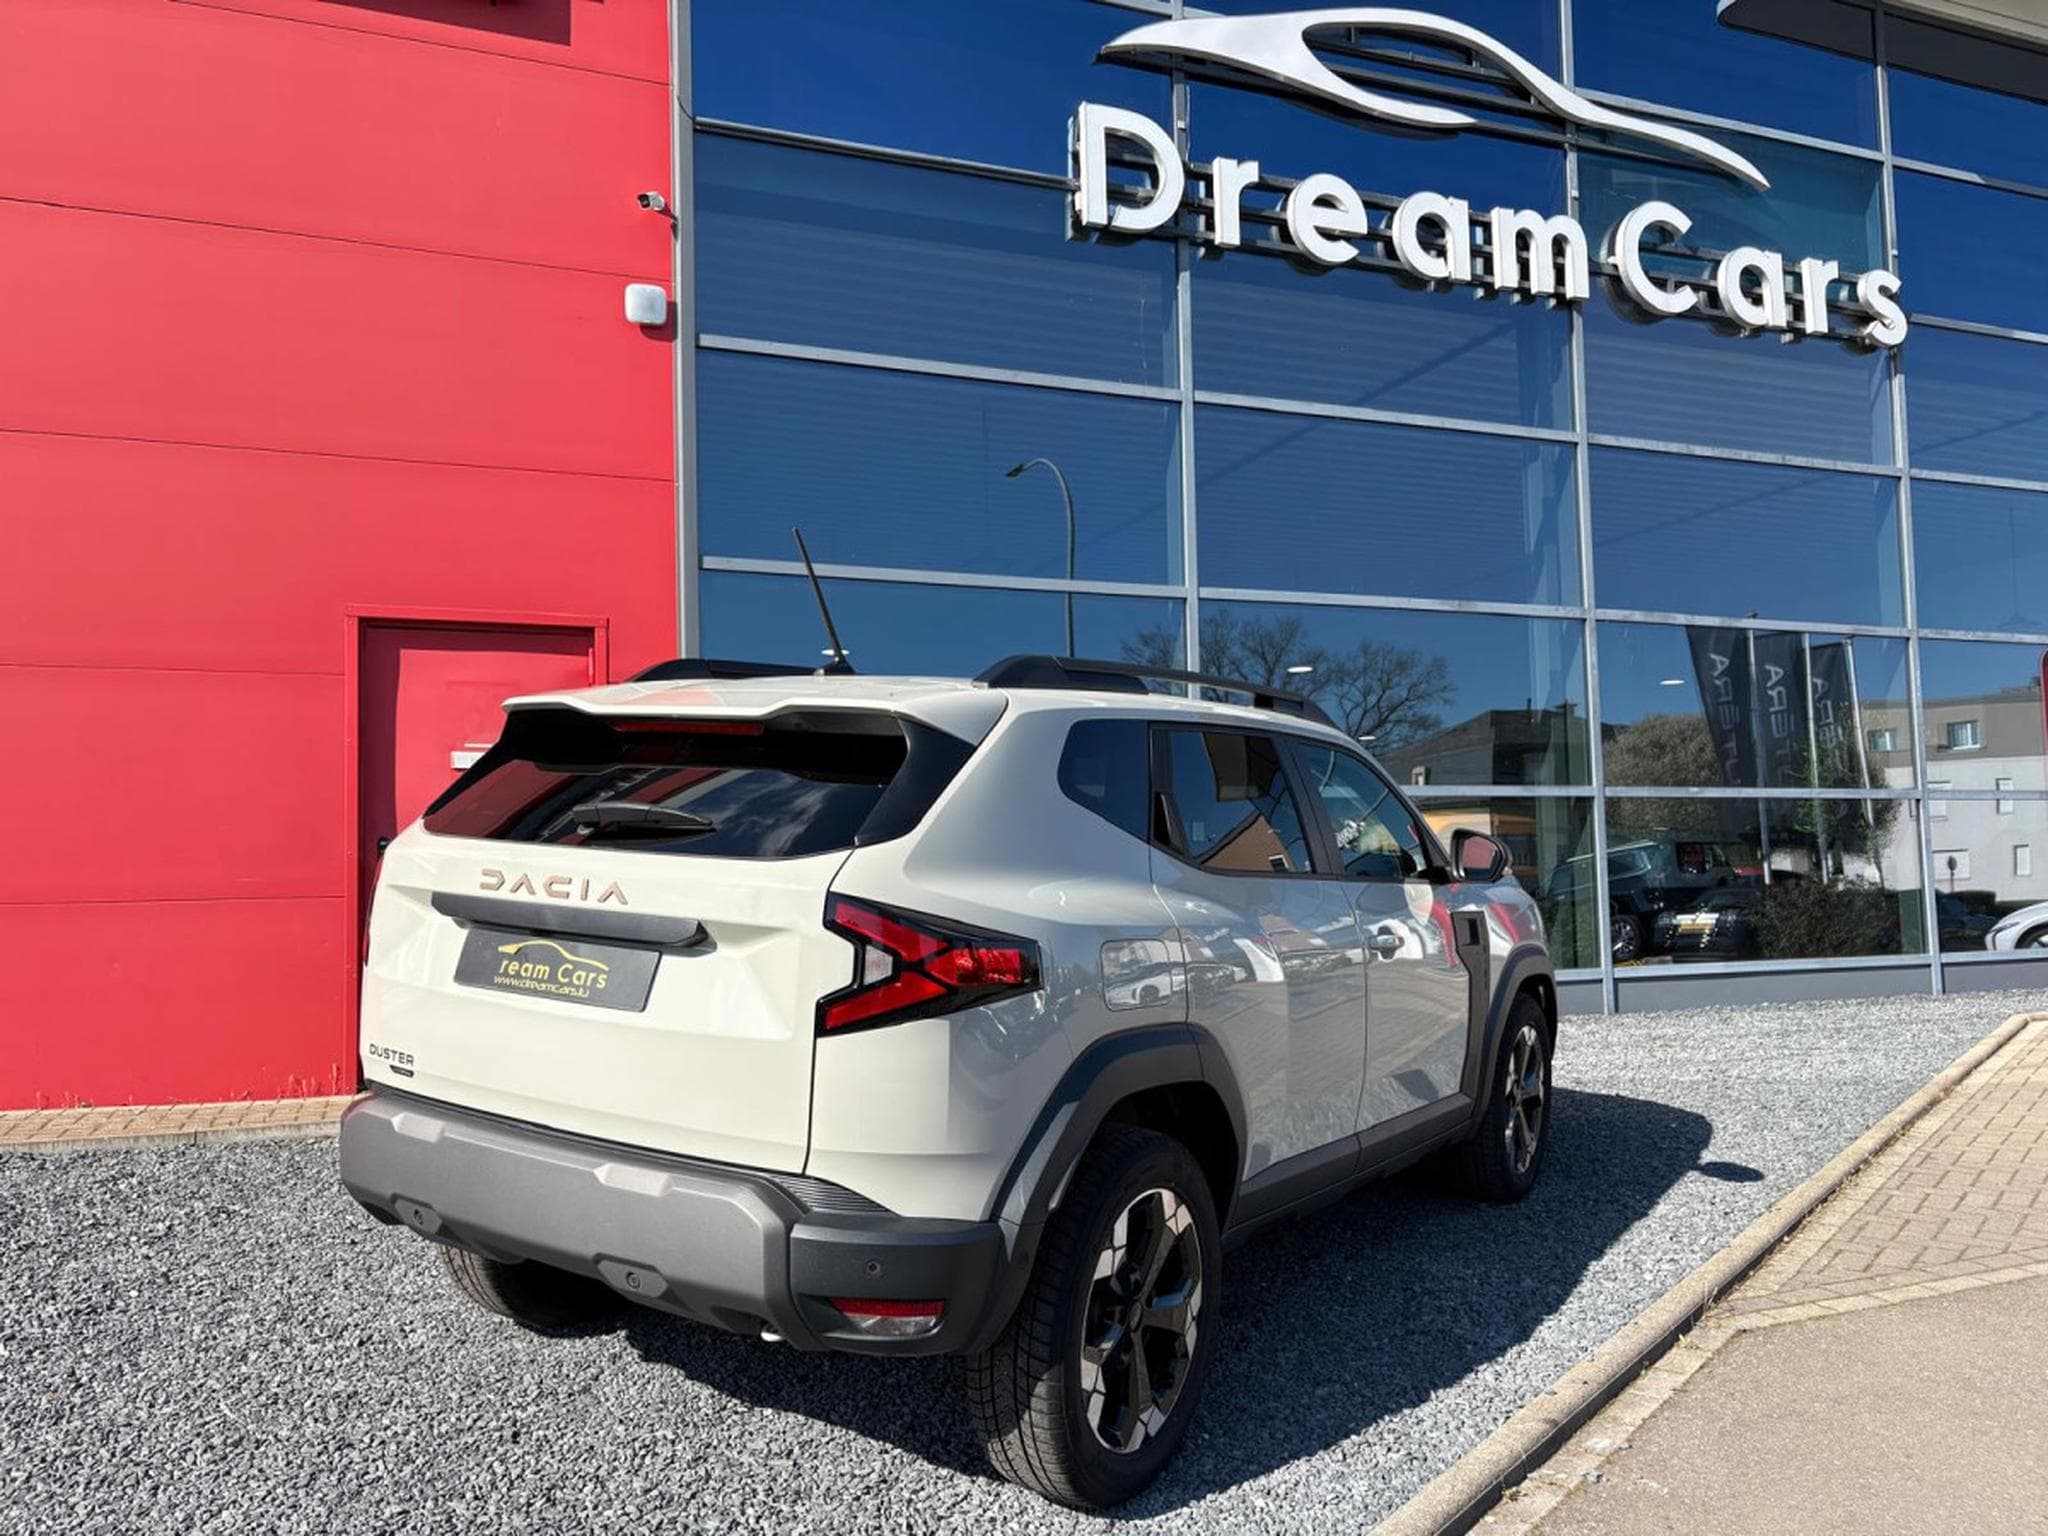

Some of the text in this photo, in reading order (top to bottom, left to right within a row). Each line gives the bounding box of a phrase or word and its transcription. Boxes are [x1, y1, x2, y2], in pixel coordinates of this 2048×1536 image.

[1077, 101, 1908, 347] Dream Cars
[479, 868, 629, 905] DACIA
[493, 975, 590, 998] www.dreamcars.lu
[557, 963, 608, 989] Cars
[369, 1043, 415, 1067] DUSTER
